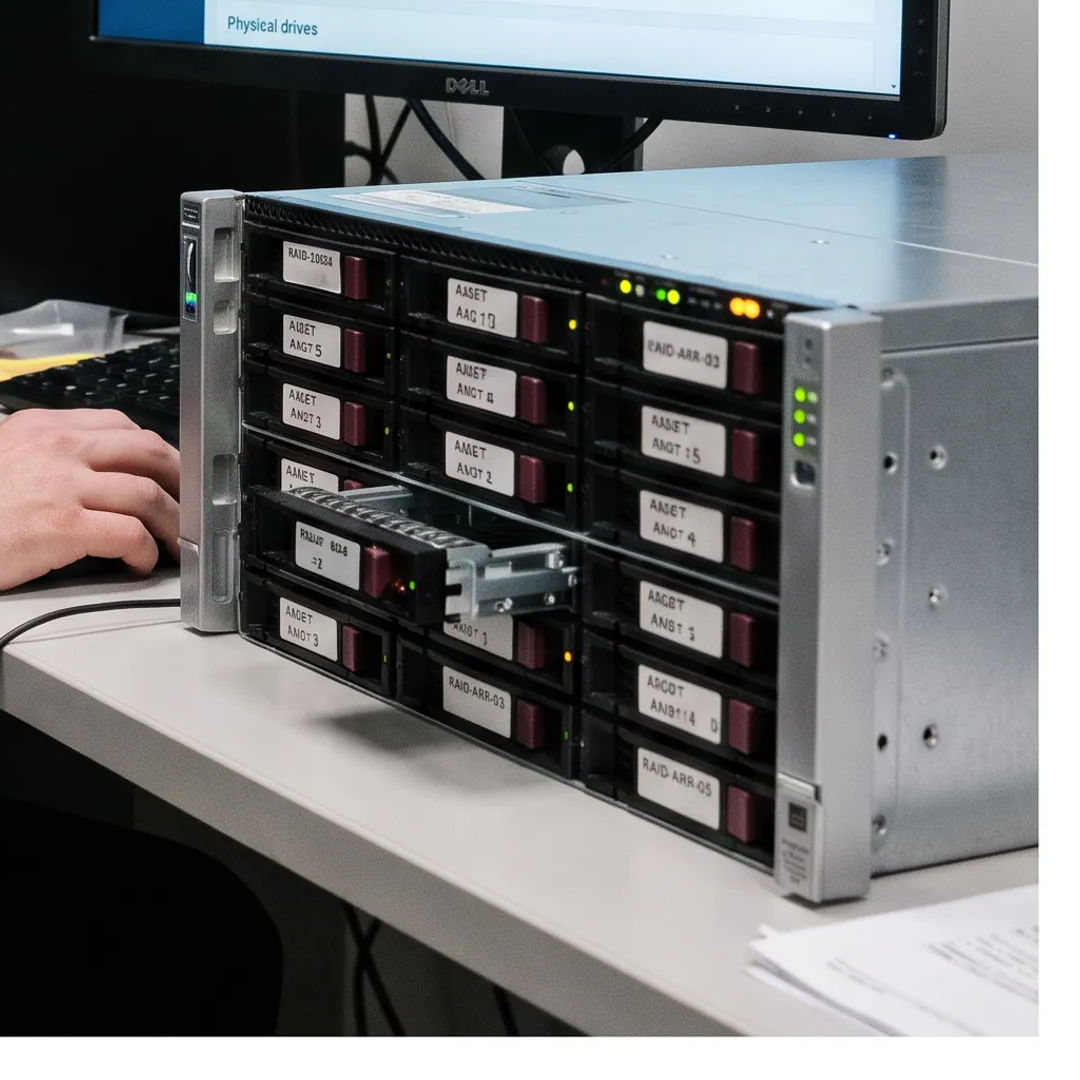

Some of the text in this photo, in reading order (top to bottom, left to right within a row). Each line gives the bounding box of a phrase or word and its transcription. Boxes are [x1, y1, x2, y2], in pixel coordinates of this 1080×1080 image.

[227, 16, 318, 36] Physical drives
[445, 77, 490, 97] DELL
[449, 675, 505, 709] RAID-ARR-03
